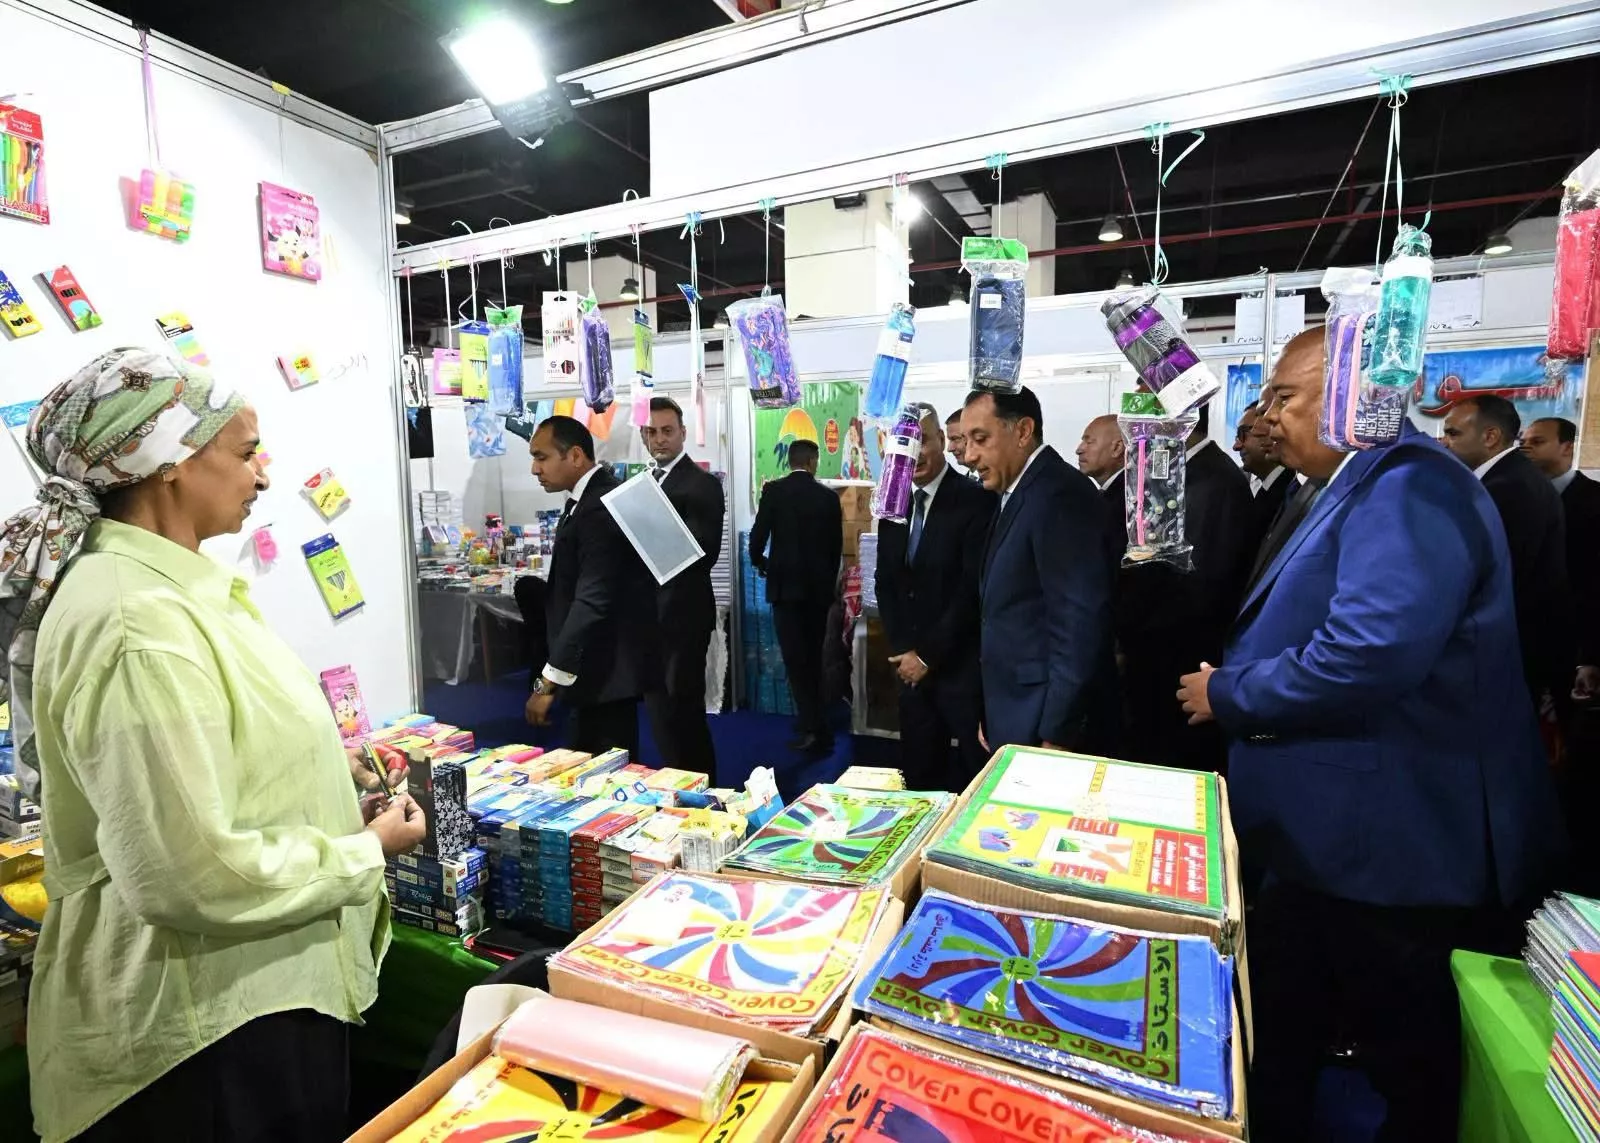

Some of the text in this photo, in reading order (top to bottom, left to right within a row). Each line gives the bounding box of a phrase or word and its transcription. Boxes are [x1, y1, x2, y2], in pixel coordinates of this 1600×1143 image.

[1353, 417, 1367, 436] THE
[1365, 412, 1378, 437] NEXT
[1376, 408, 1389, 437] RIGHT
[1387, 407, 1402, 438] THING
[579, 946, 816, 1014] Cover Cover Cover
[876, 981, 1169, 1078] Cover Cover Cover
[865, 1048, 1073, 1143] Cover Cover
